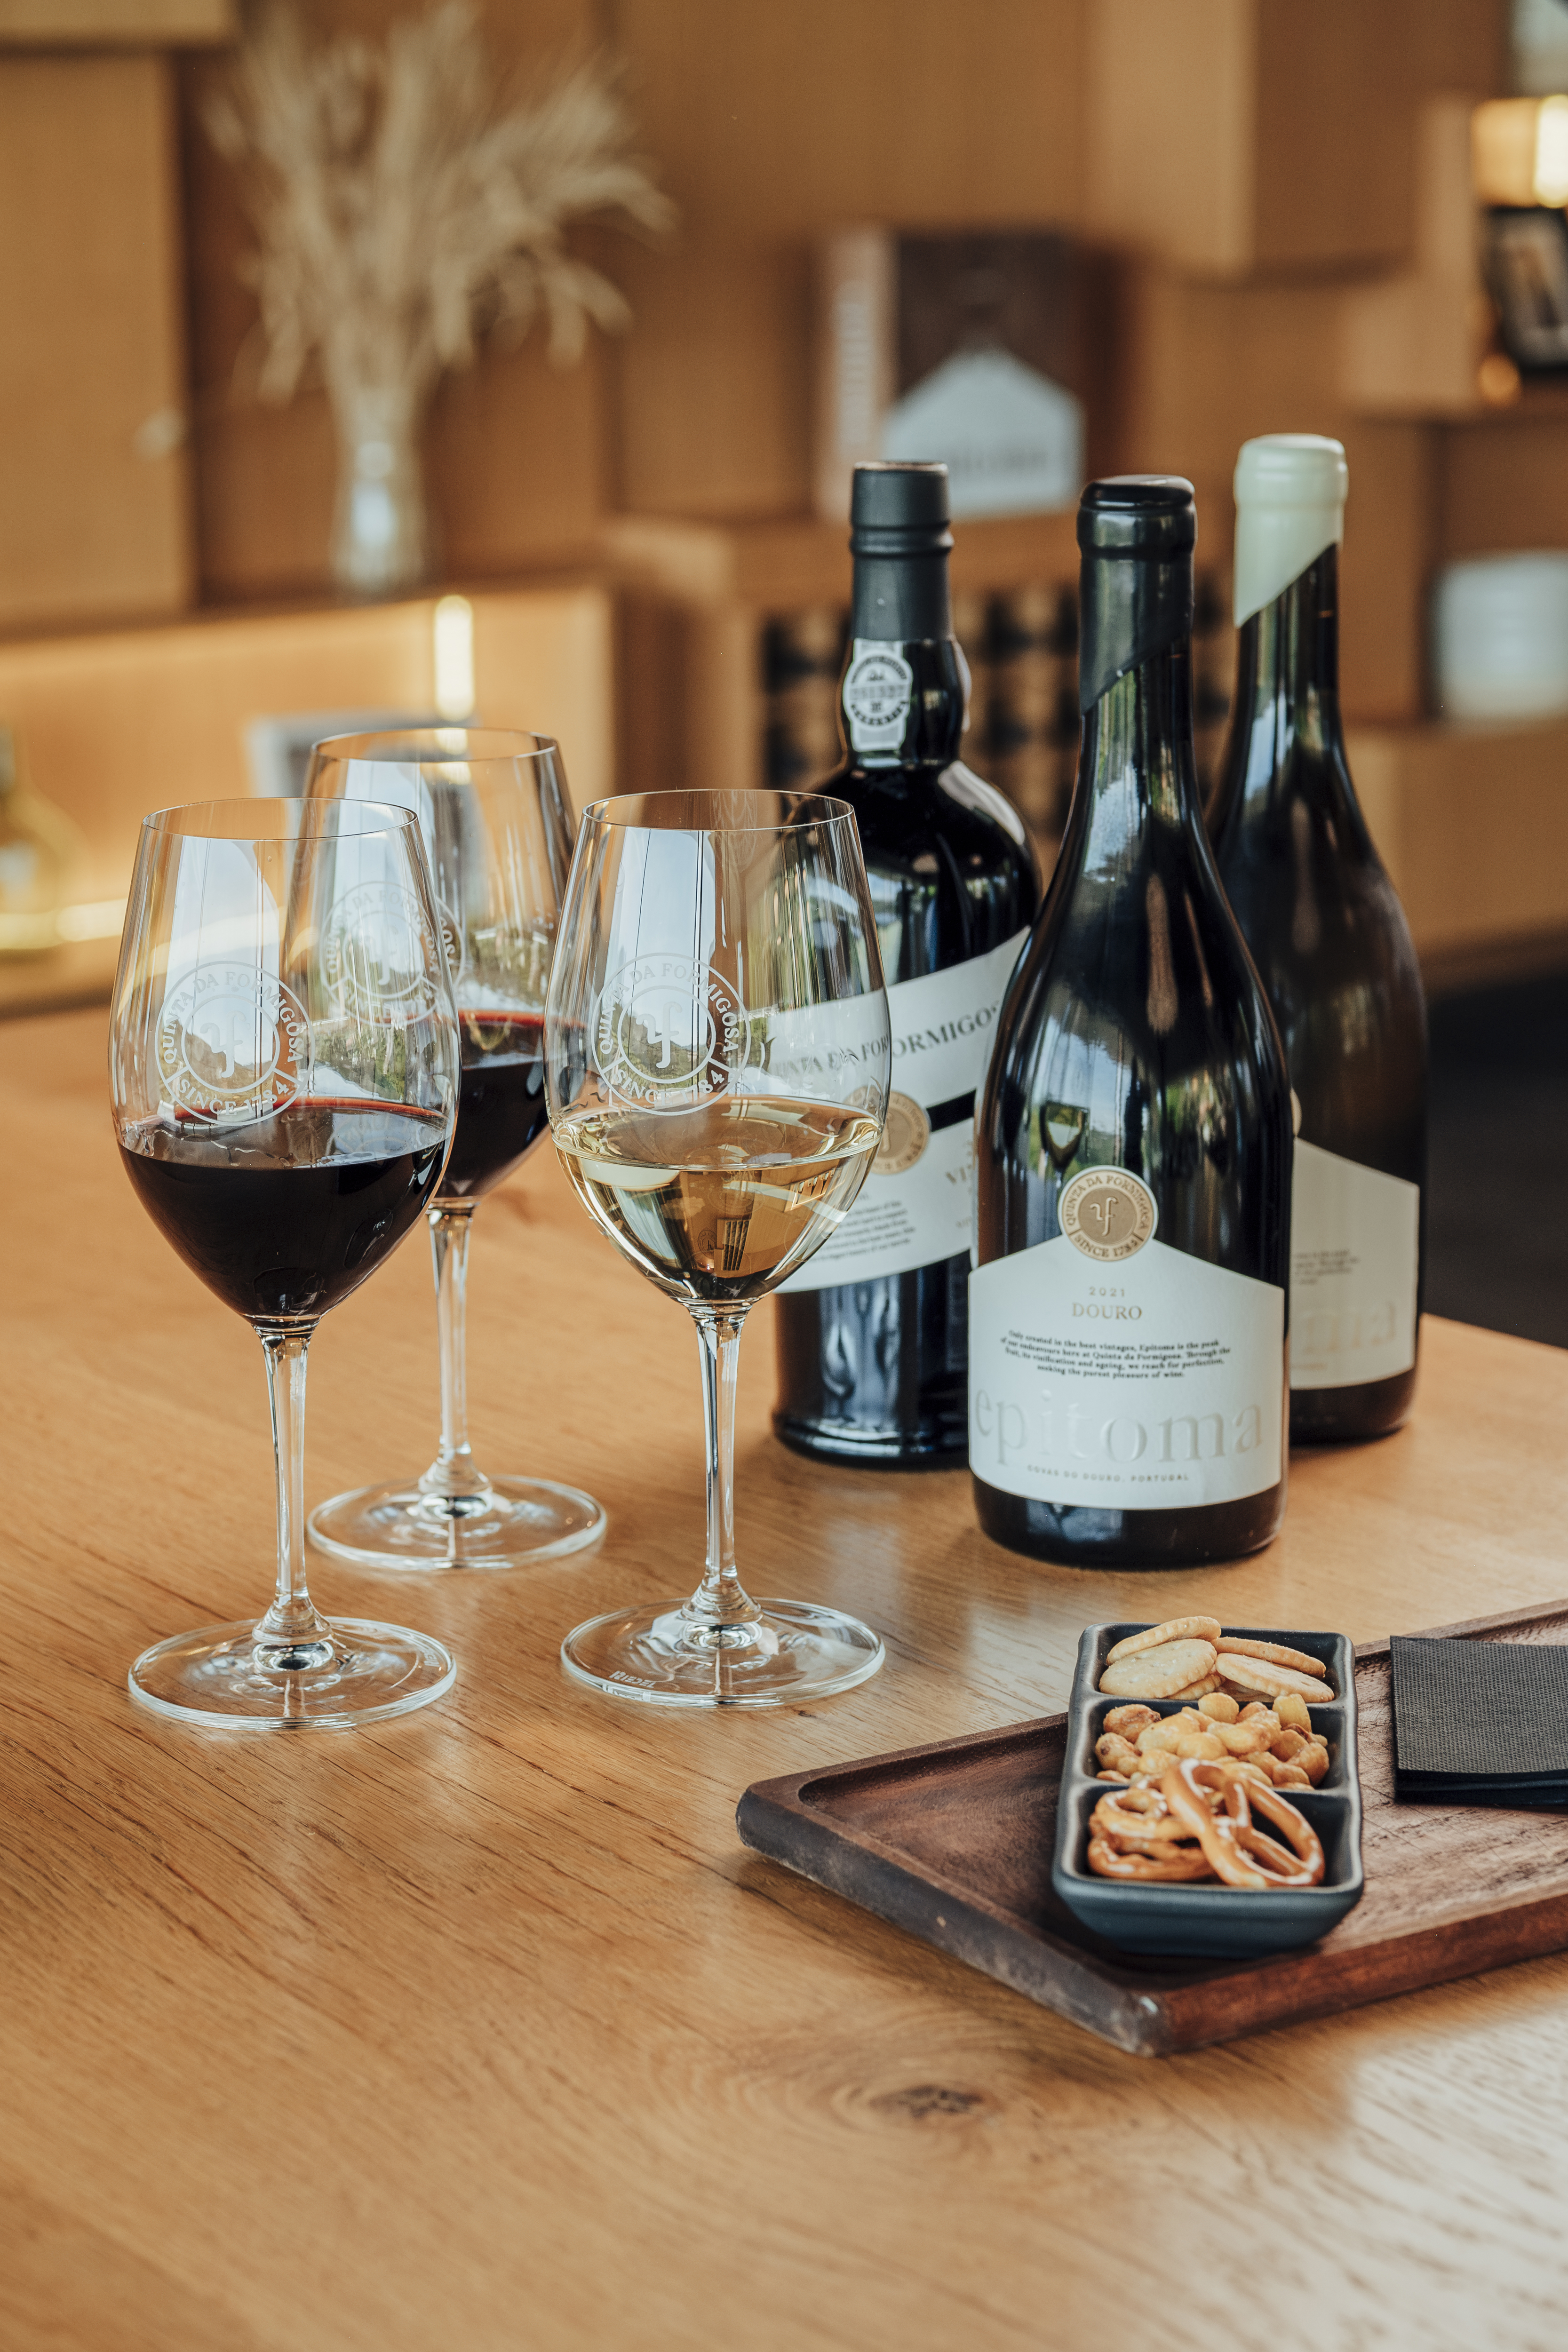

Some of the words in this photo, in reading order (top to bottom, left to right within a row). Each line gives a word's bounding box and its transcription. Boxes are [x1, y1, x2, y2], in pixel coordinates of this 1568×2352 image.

[162, 991, 194, 1064] QUINTA
[193, 973, 219, 994] DA
[225, 971, 303, 1063] FORMIGOSA
[599, 982, 630, 1055] QUINTA
[629, 965, 656, 985] DA
[661, 962, 740, 1053] FORMIGOSA
[177, 1079, 237, 1116] SINCE
[243, 1080, 289, 1114] 1784
[613, 1069, 673, 1106] SINCE
[679, 1069, 725, 1104] 1784
[1067, 1184, 1086, 1226] QUINTA
[1086, 1176, 1103, 1187] DA
[1106, 1175, 1149, 1229] FORMIGOSA
[1074, 1234, 1109, 1258] SINCE
[1089, 1286, 1125, 1298] 2021
[1072, 1302, 1142, 1320] DOURO
[1062, 1348, 1080, 1357] here
[1092, 1351, 1122, 1360] Quinta
[1186, 1349, 1217, 1359] Through
[1219, 1347, 1231, 1355] the
[1201, 1338, 1219, 1349] peak
[1141, 1361, 1165, 1369] reach
[975, 1389, 1264, 1467] epitoma
[1064, 1470, 1078, 1479] DO
[1130, 1472, 1189, 1483] PORTUGAL
[609, 1670, 657, 1689] RIEDEL
